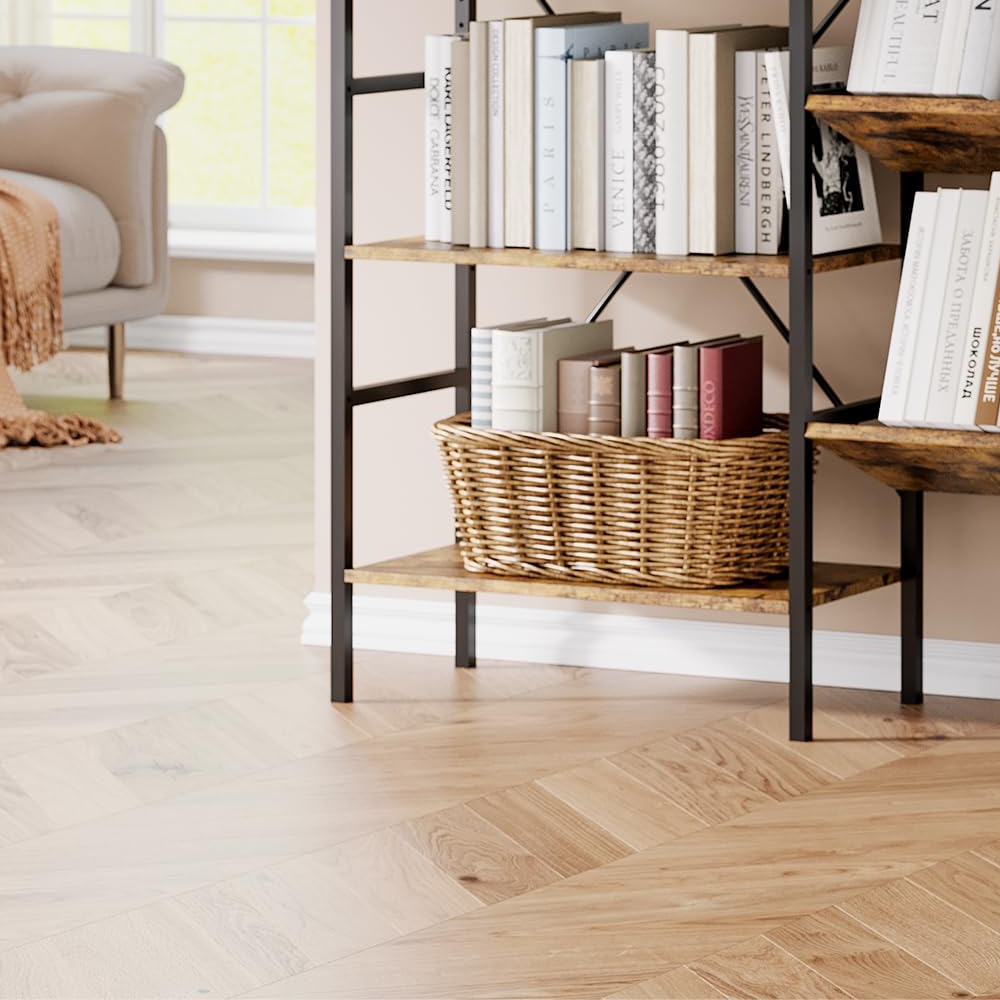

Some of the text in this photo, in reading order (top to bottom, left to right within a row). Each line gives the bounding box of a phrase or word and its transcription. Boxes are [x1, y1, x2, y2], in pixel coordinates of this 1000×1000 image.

[543, 96, 555, 213] PARIS
[611, 149, 625, 231] VENICE
[761, 132, 772, 244] LINDBERGH
[937, 229, 974, 393] ЗАБОТА О ПРЕДАННЫХ
[962, 326, 982, 400] ШОКОЛАД
[982, 355, 1000, 403] ЛУЧШЕ
[703, 380, 716, 440] NDECO
